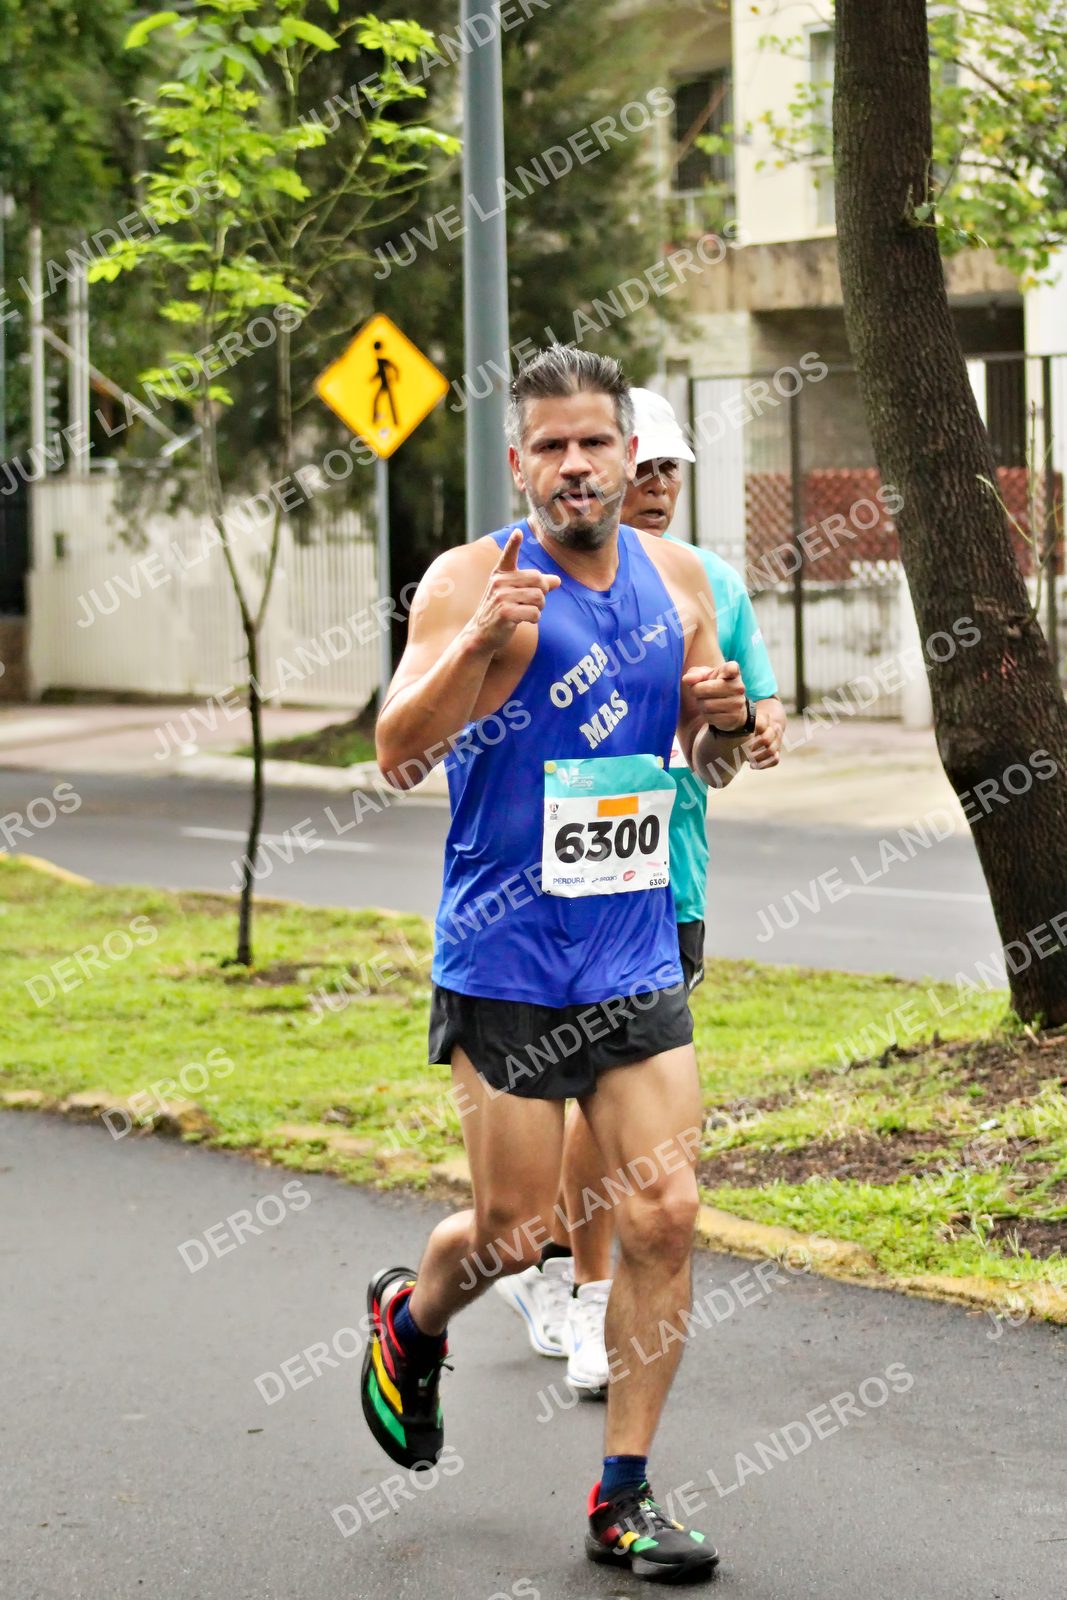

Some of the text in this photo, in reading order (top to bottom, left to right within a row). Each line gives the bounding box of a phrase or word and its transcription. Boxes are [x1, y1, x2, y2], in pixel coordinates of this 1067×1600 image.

[550, 642, 608, 708] OTRA
[579, 689, 628, 749] MAS
[554, 814, 660, 864] 6300
[553, 876, 586, 885] PERDURA
[650, 878, 666, 886] 6300
